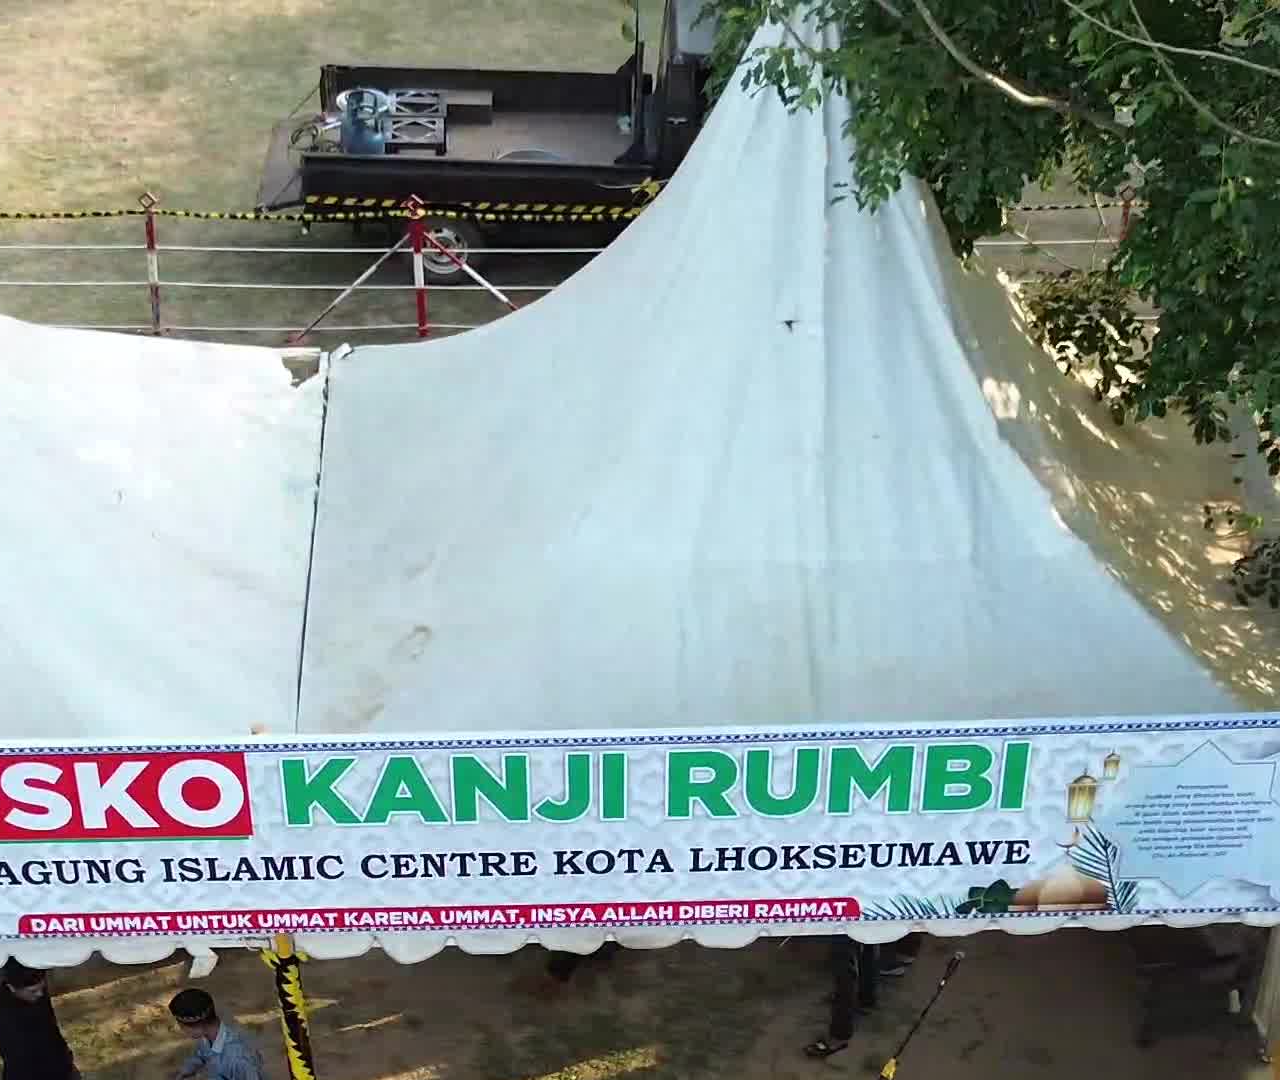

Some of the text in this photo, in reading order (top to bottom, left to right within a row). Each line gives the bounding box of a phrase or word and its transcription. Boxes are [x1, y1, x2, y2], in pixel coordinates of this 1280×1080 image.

[279, 750, 629, 830] KANJI
[666, 738, 1034, 820] RUMBI
[160, 855, 345, 882] ISLAMIC
[360, 851, 538, 879] CENTRE
[553, 848, 674, 875] KOTA
[689, 839, 1031, 872] LHOKSEUMAWE
[31, 901, 847, 933] DARI UMMAT UNTUK UMMAT KARENA UMMAT, INSYA ALLAH DIBERI RAHMAT
